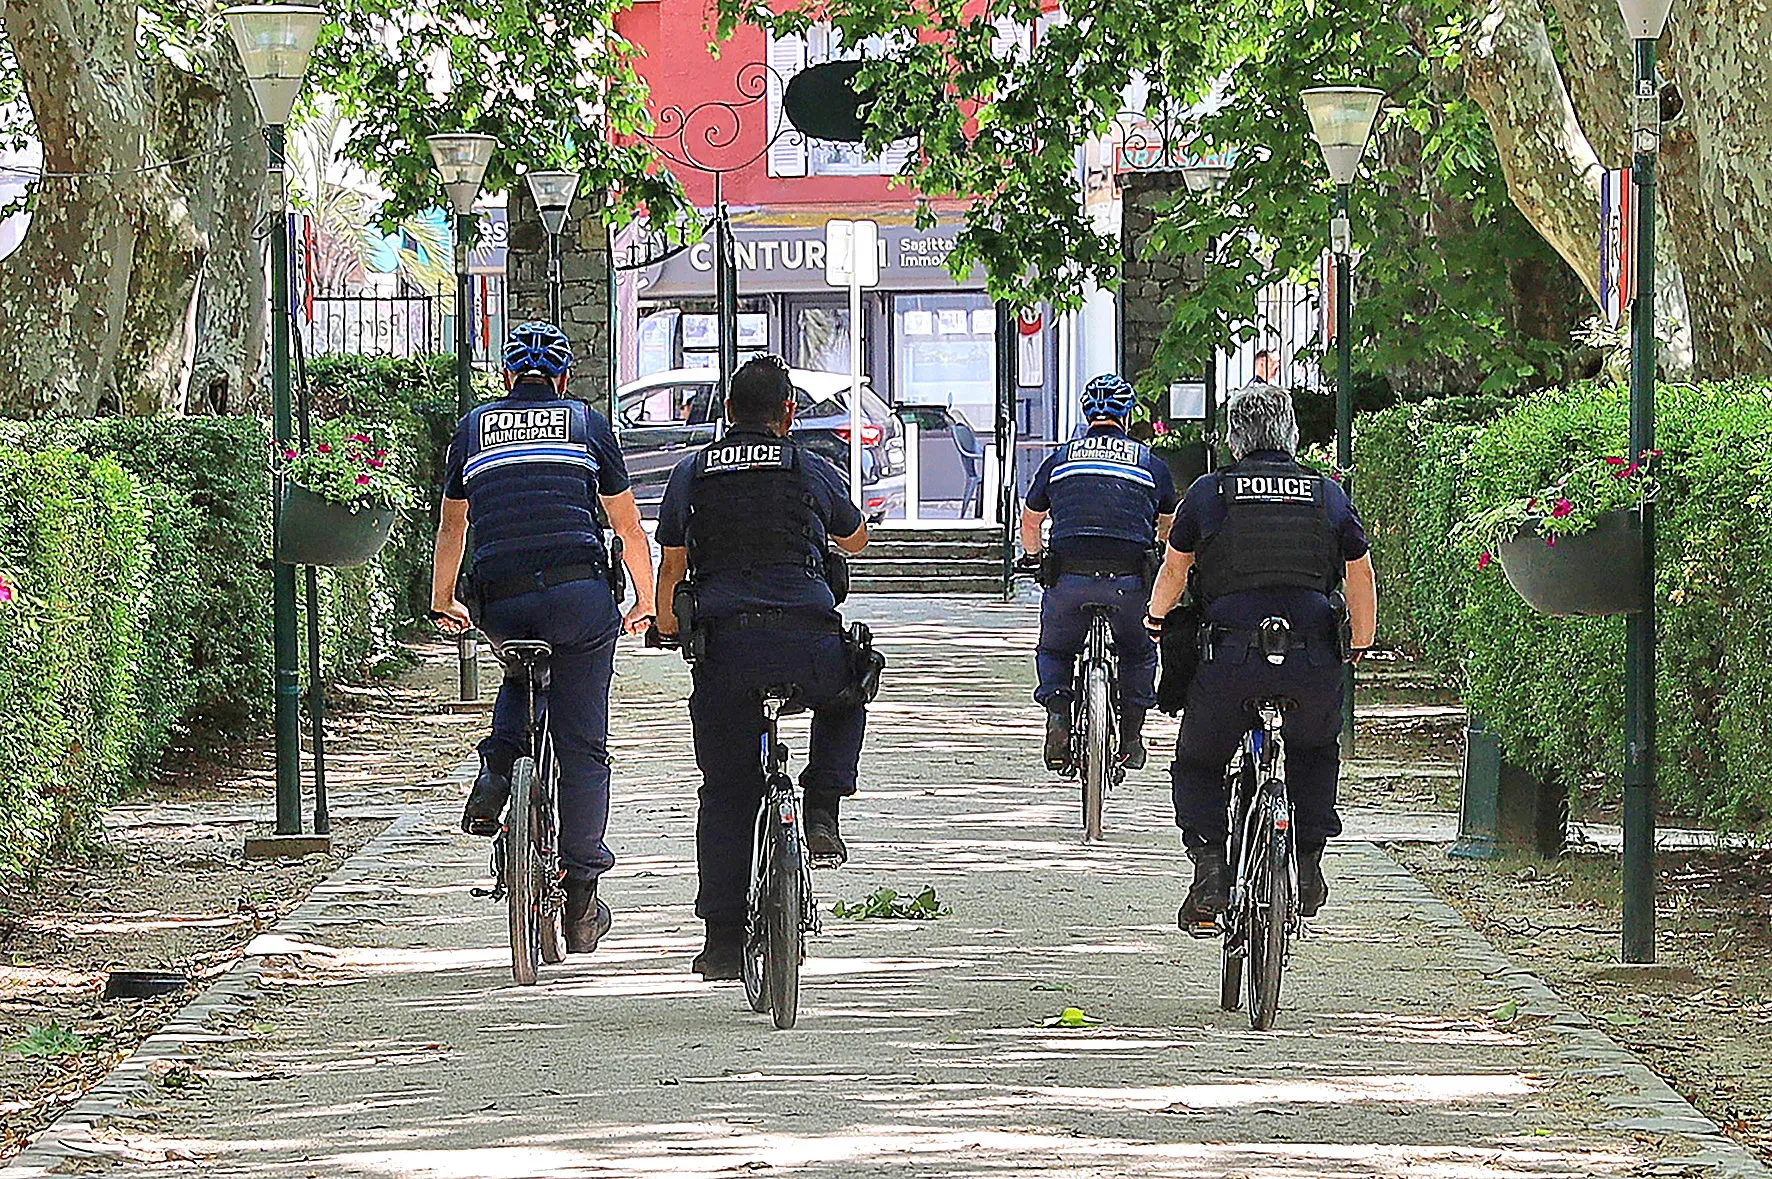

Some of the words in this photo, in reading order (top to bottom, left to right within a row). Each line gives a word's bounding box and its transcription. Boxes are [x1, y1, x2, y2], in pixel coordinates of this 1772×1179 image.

[690, 241, 827, 271] CNTUR
[484, 410, 565, 433] POLICE
[484, 426, 565, 446] MUNICIPALE
[1072, 435, 1135, 454] POLICE
[706, 444, 781, 467] POLICE
[1072, 449, 1134, 462] MUNICIPALE
[1236, 477, 1312, 497] POLICE
